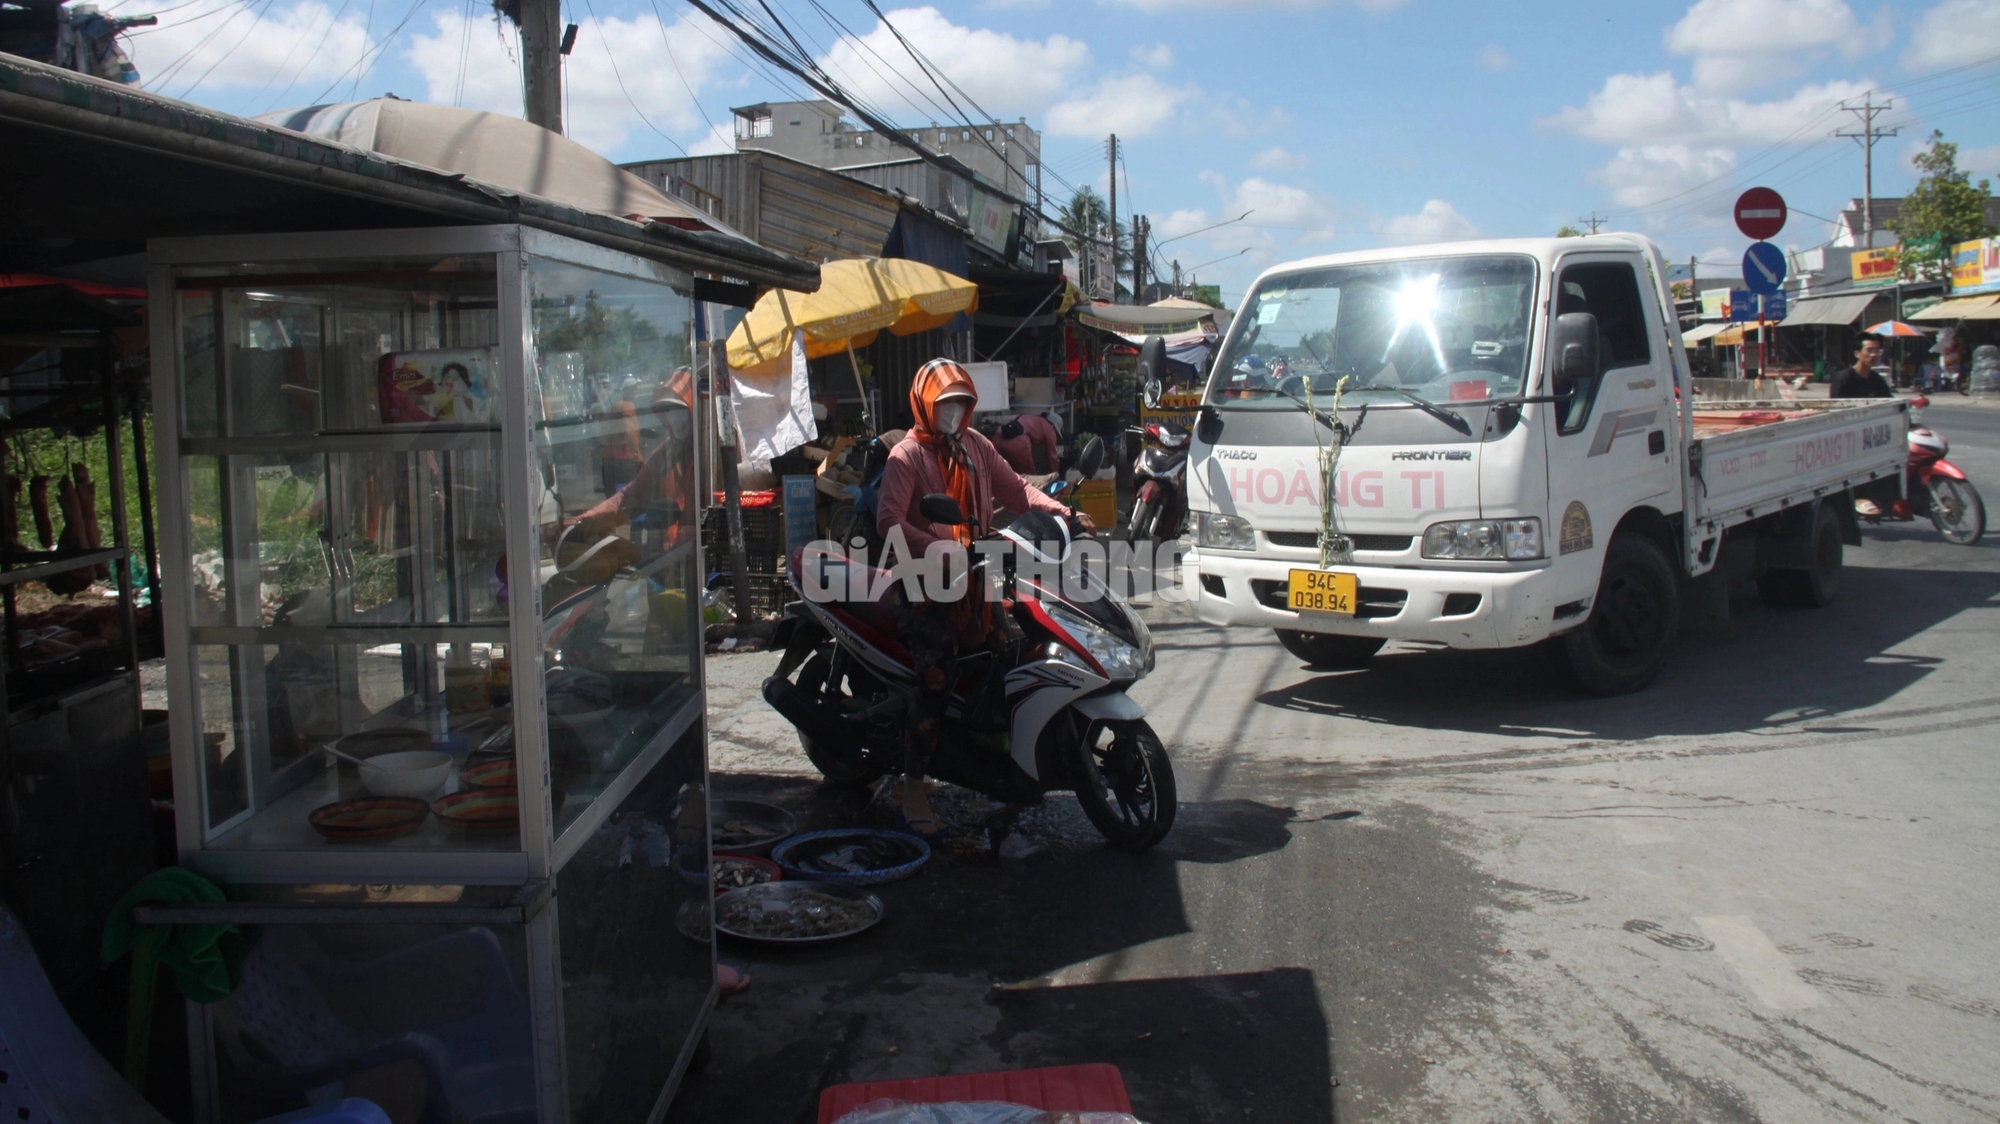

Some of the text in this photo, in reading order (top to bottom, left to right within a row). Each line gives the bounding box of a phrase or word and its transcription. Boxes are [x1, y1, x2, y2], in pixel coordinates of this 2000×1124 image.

[1217, 450, 1257, 460] THACO
[1392, 450, 1472, 461] FRONTIER
[1230, 459, 1445, 509] HOÀNG TI
[1307, 573, 1336, 590] 94C
[1295, 591, 1347, 612] 038.94
[1057, 668, 1085, 683] HONDA
